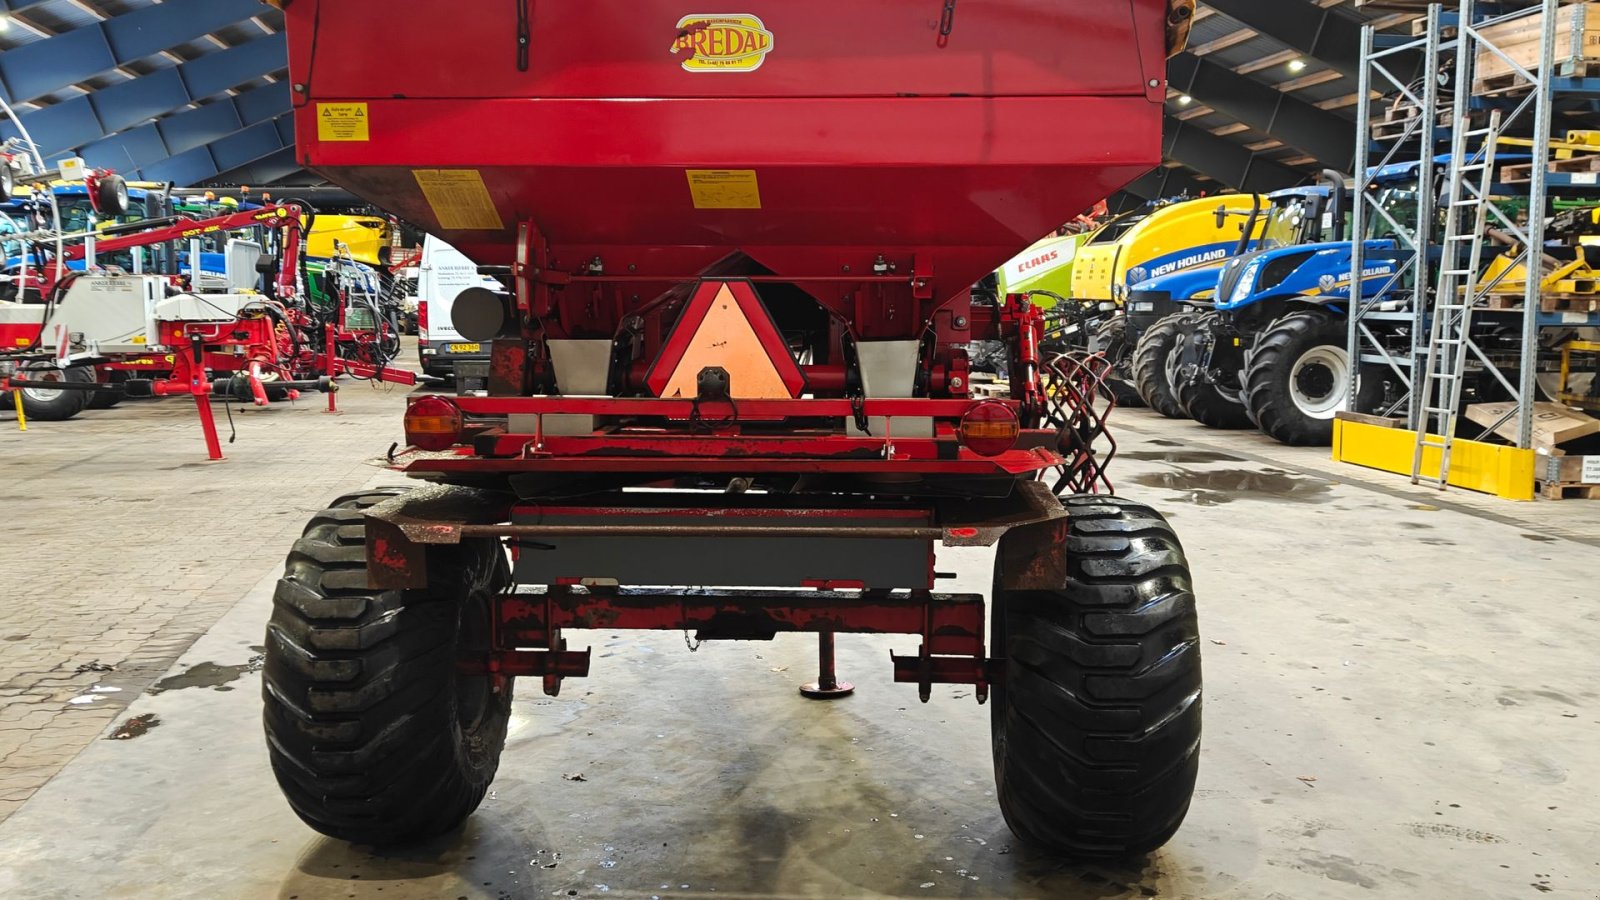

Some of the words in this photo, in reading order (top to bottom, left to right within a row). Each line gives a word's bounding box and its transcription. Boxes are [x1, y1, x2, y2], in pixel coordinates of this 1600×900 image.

[675, 28, 767, 58] BREDAL
[1018, 250, 1058, 273] CLAAS
[1151, 262, 1177, 278] NEW
[1177, 249, 1226, 269] HOLLAND
[1338, 272, 1352, 281] NE
[1362, 265, 1391, 277] OLLAND
